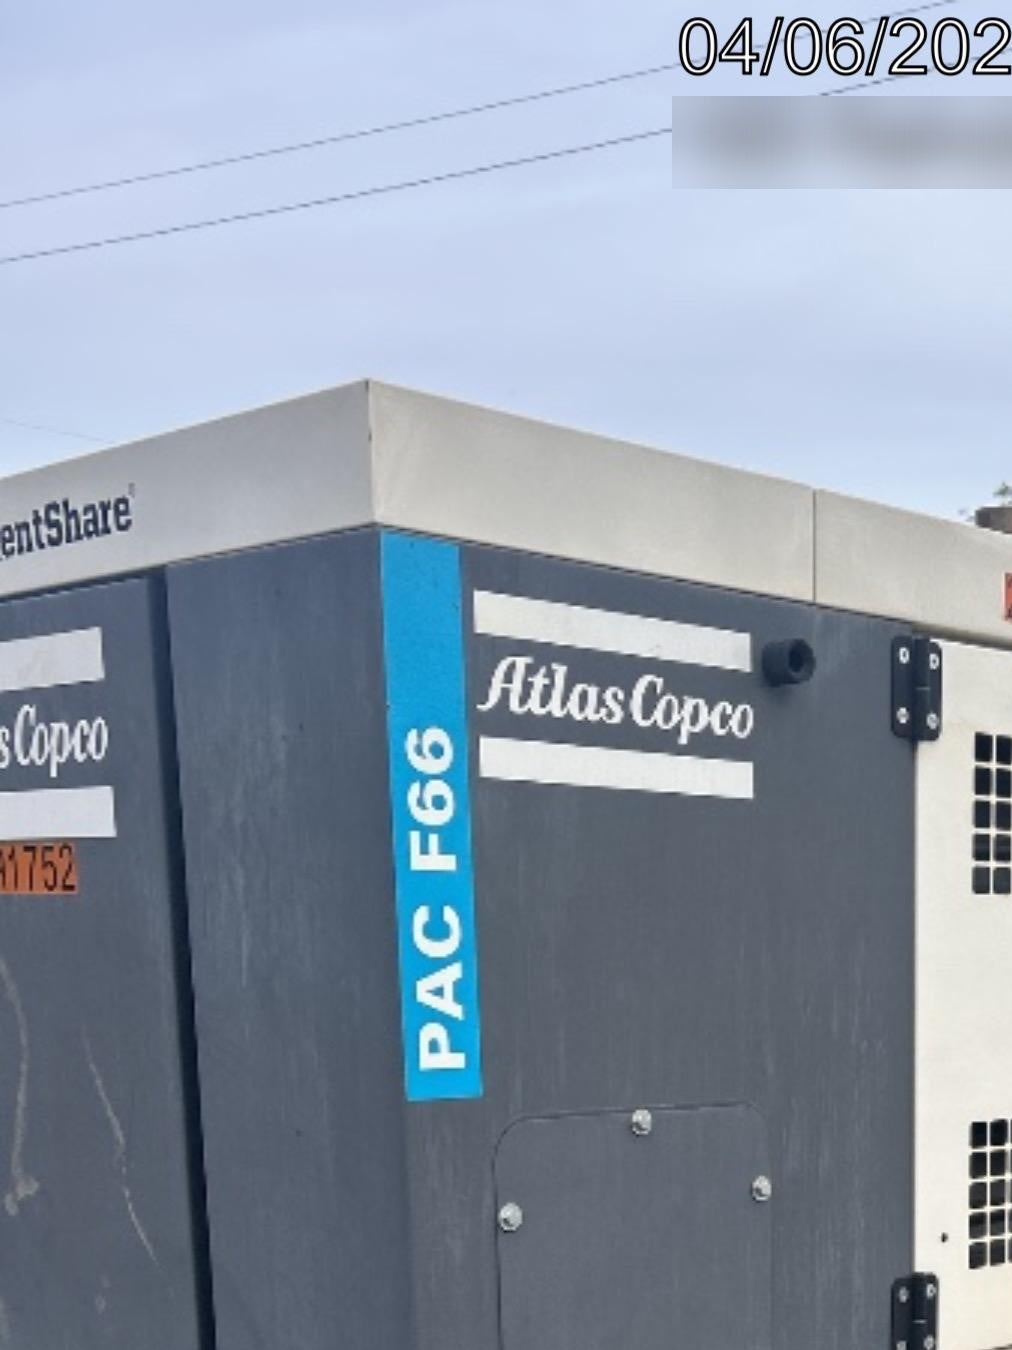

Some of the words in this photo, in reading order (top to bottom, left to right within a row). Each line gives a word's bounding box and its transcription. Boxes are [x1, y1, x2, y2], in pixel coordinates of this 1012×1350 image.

[0, 496, 132, 561] entShare
[14, 703, 109, 778] Copco
[477, 655, 626, 725] Atlas
[629, 674, 755, 745] Copco
[404, 725, 457, 872] F66
[411, 904, 467, 1072] PAC
